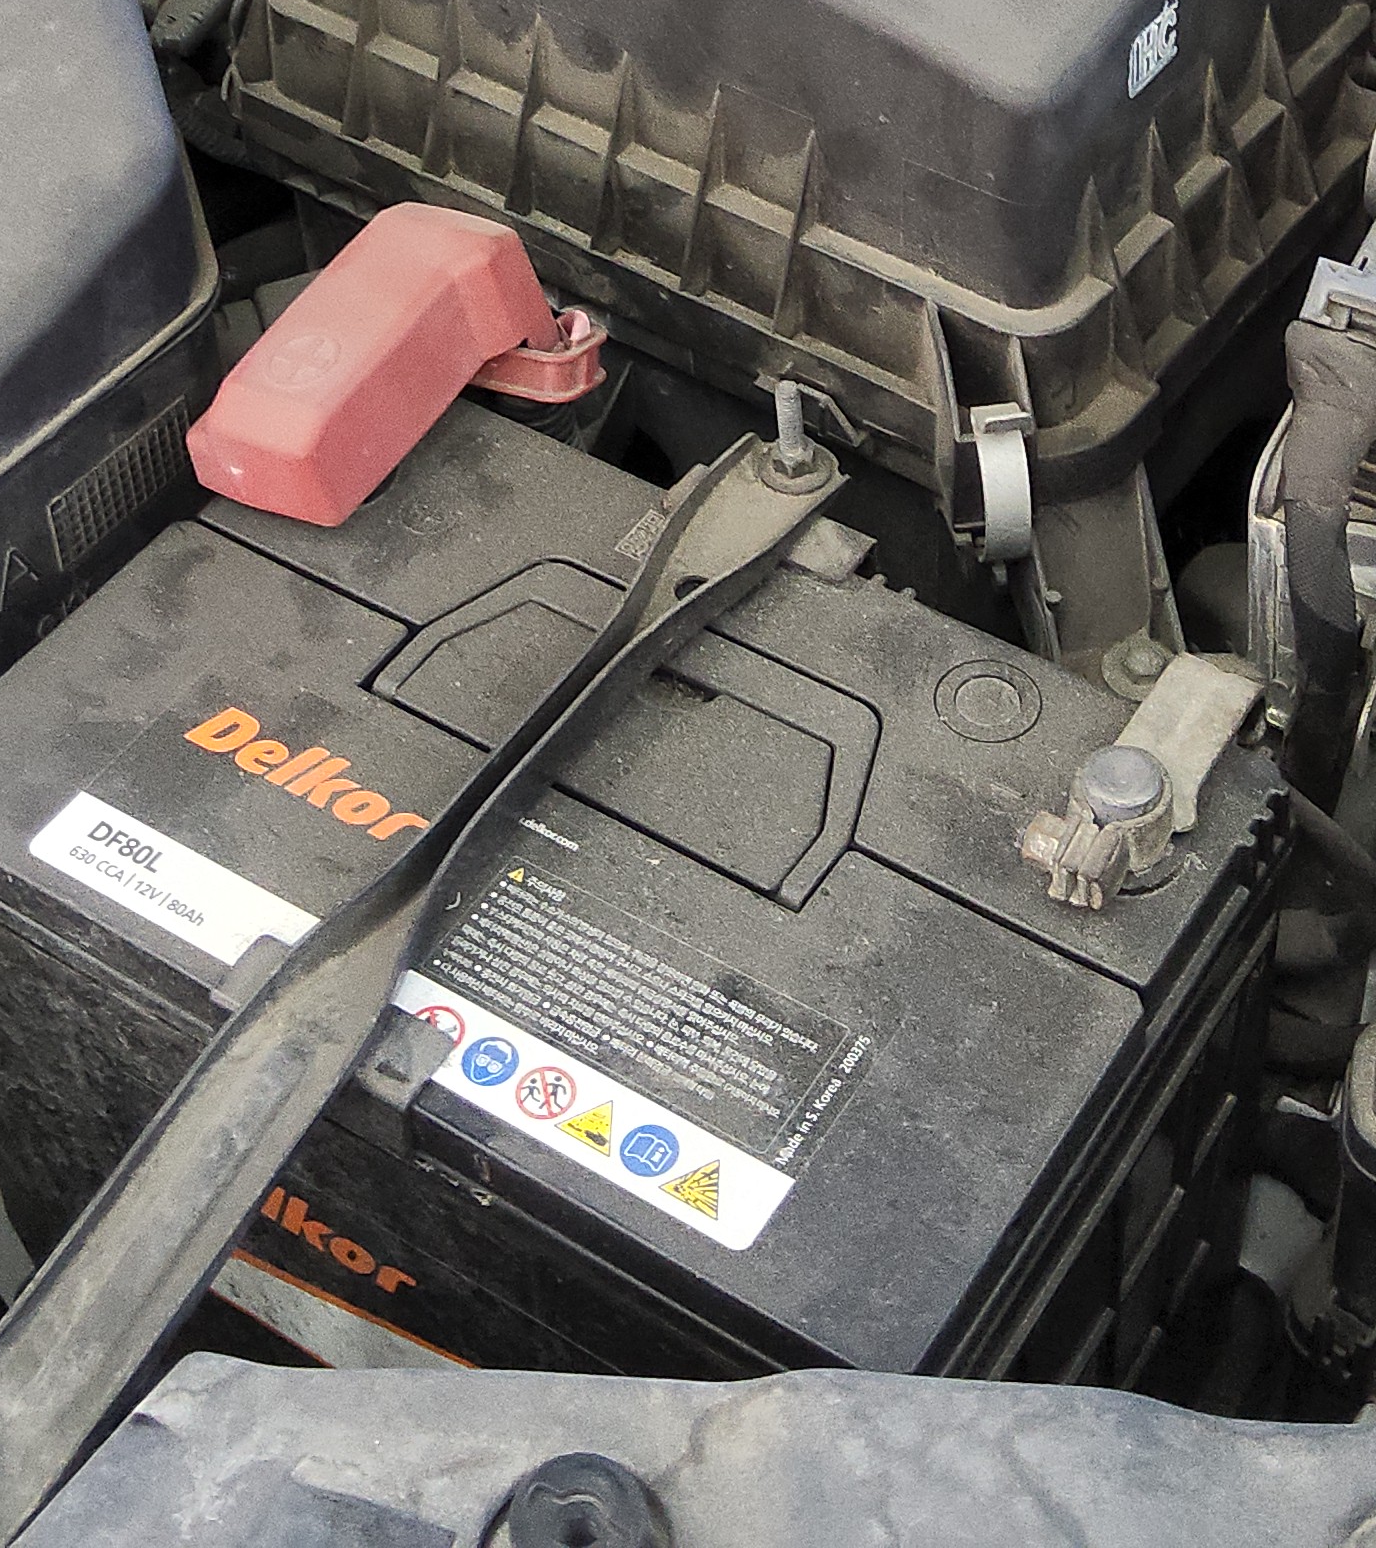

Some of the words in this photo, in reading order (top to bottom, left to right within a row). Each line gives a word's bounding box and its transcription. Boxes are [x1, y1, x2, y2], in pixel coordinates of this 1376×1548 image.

[183, 706, 430, 841] Delkor
[87, 821, 163, 873] DF80L
[69, 846, 96, 864] 630
[96, 860, 124, 882] CCA
[134, 881, 163, 900] 12V
[167, 900, 204, 927] 80Ah
[813, 1078, 842, 1111] Korea
[799, 1120, 813, 1134] in
[805, 1111, 821, 1122] S.
[775, 1133, 804, 1166] Made
[260, 1186, 417, 1293] lkor
